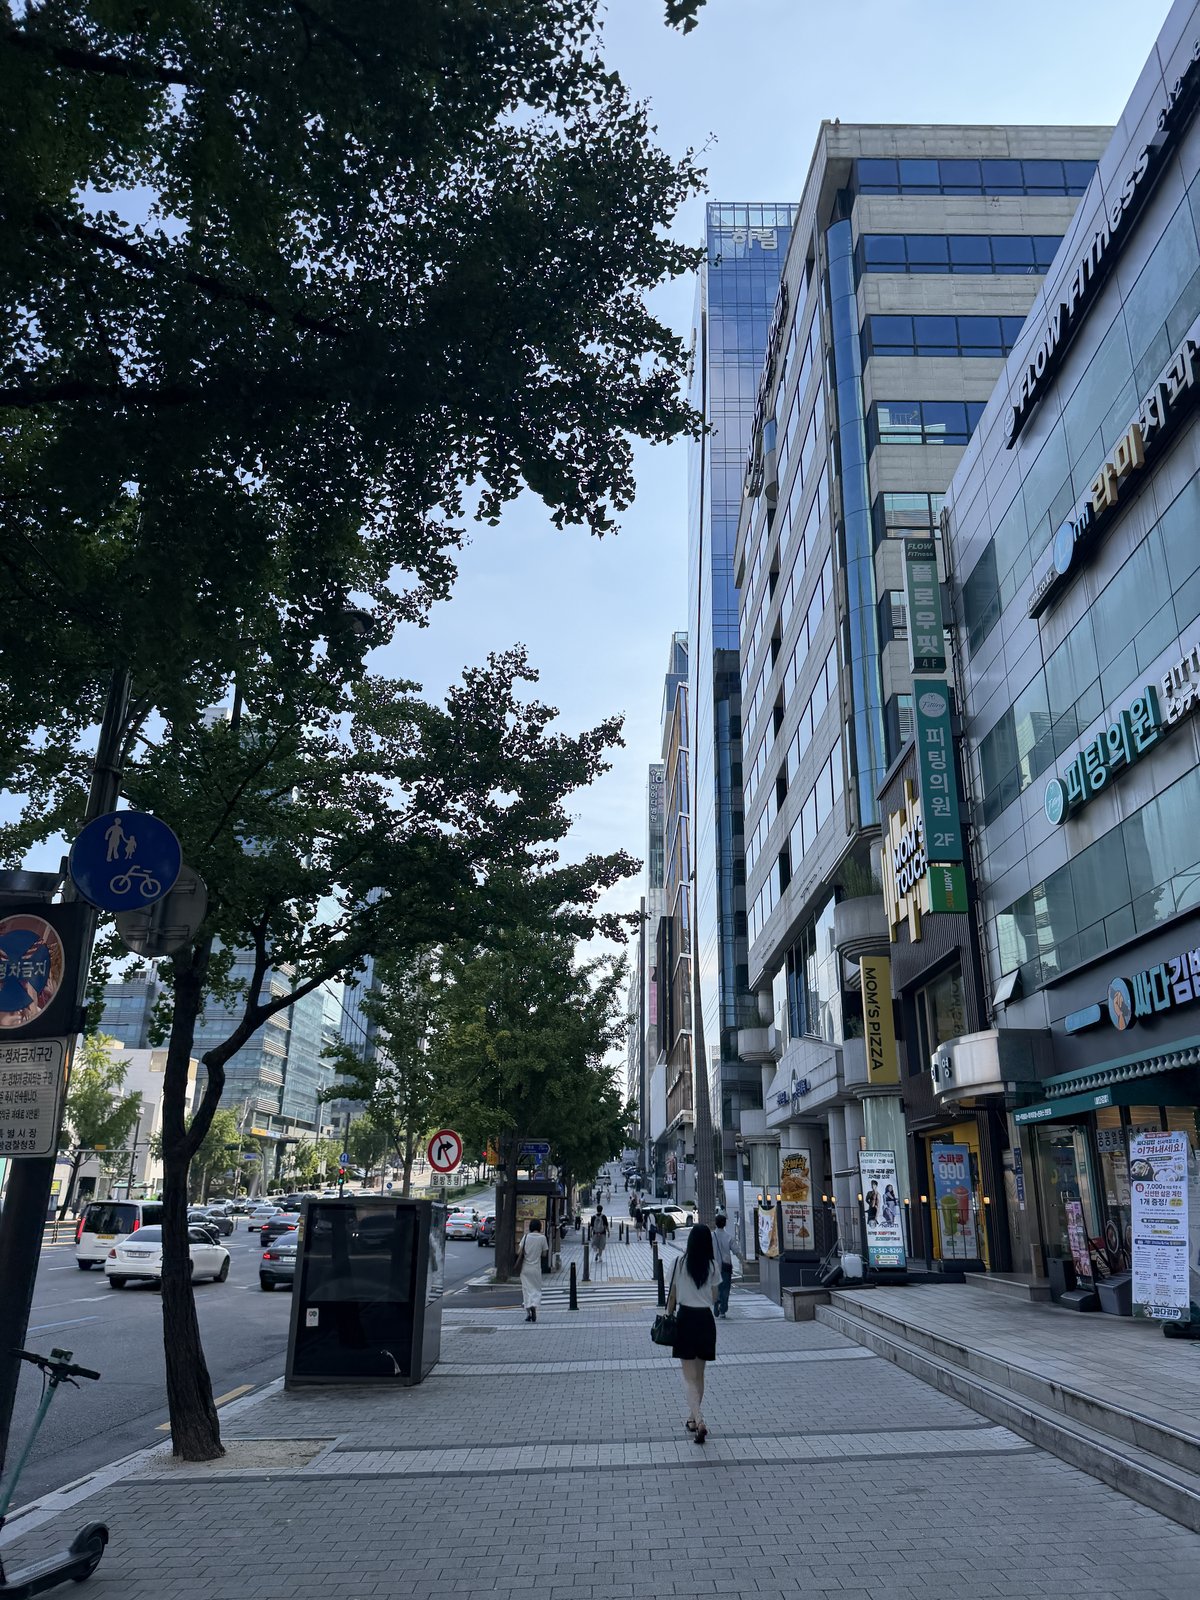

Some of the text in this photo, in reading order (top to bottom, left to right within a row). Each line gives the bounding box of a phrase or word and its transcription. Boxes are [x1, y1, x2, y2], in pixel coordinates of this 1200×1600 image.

[1017, 303, 1064, 413] FLOW
[1091, 341, 1197, 511] 라미치과
[911, 564, 938, 654] 플로우핏
[925, 728, 951, 817] 피팅의원
[1064, 685, 1159, 801] 피팅의원
[893, 816, 924, 871] MOM'S
[895, 849, 928, 899] TOUCH
[934, 833, 955, 846] 2F
[865, 967, 884, 1070] MOM'S PIZZA
[938, 1163, 966, 1180] 990
[1137, 1143, 1184, 1154] 이겨내세요!
[1151, 1199, 1168, 1207] 증정!
